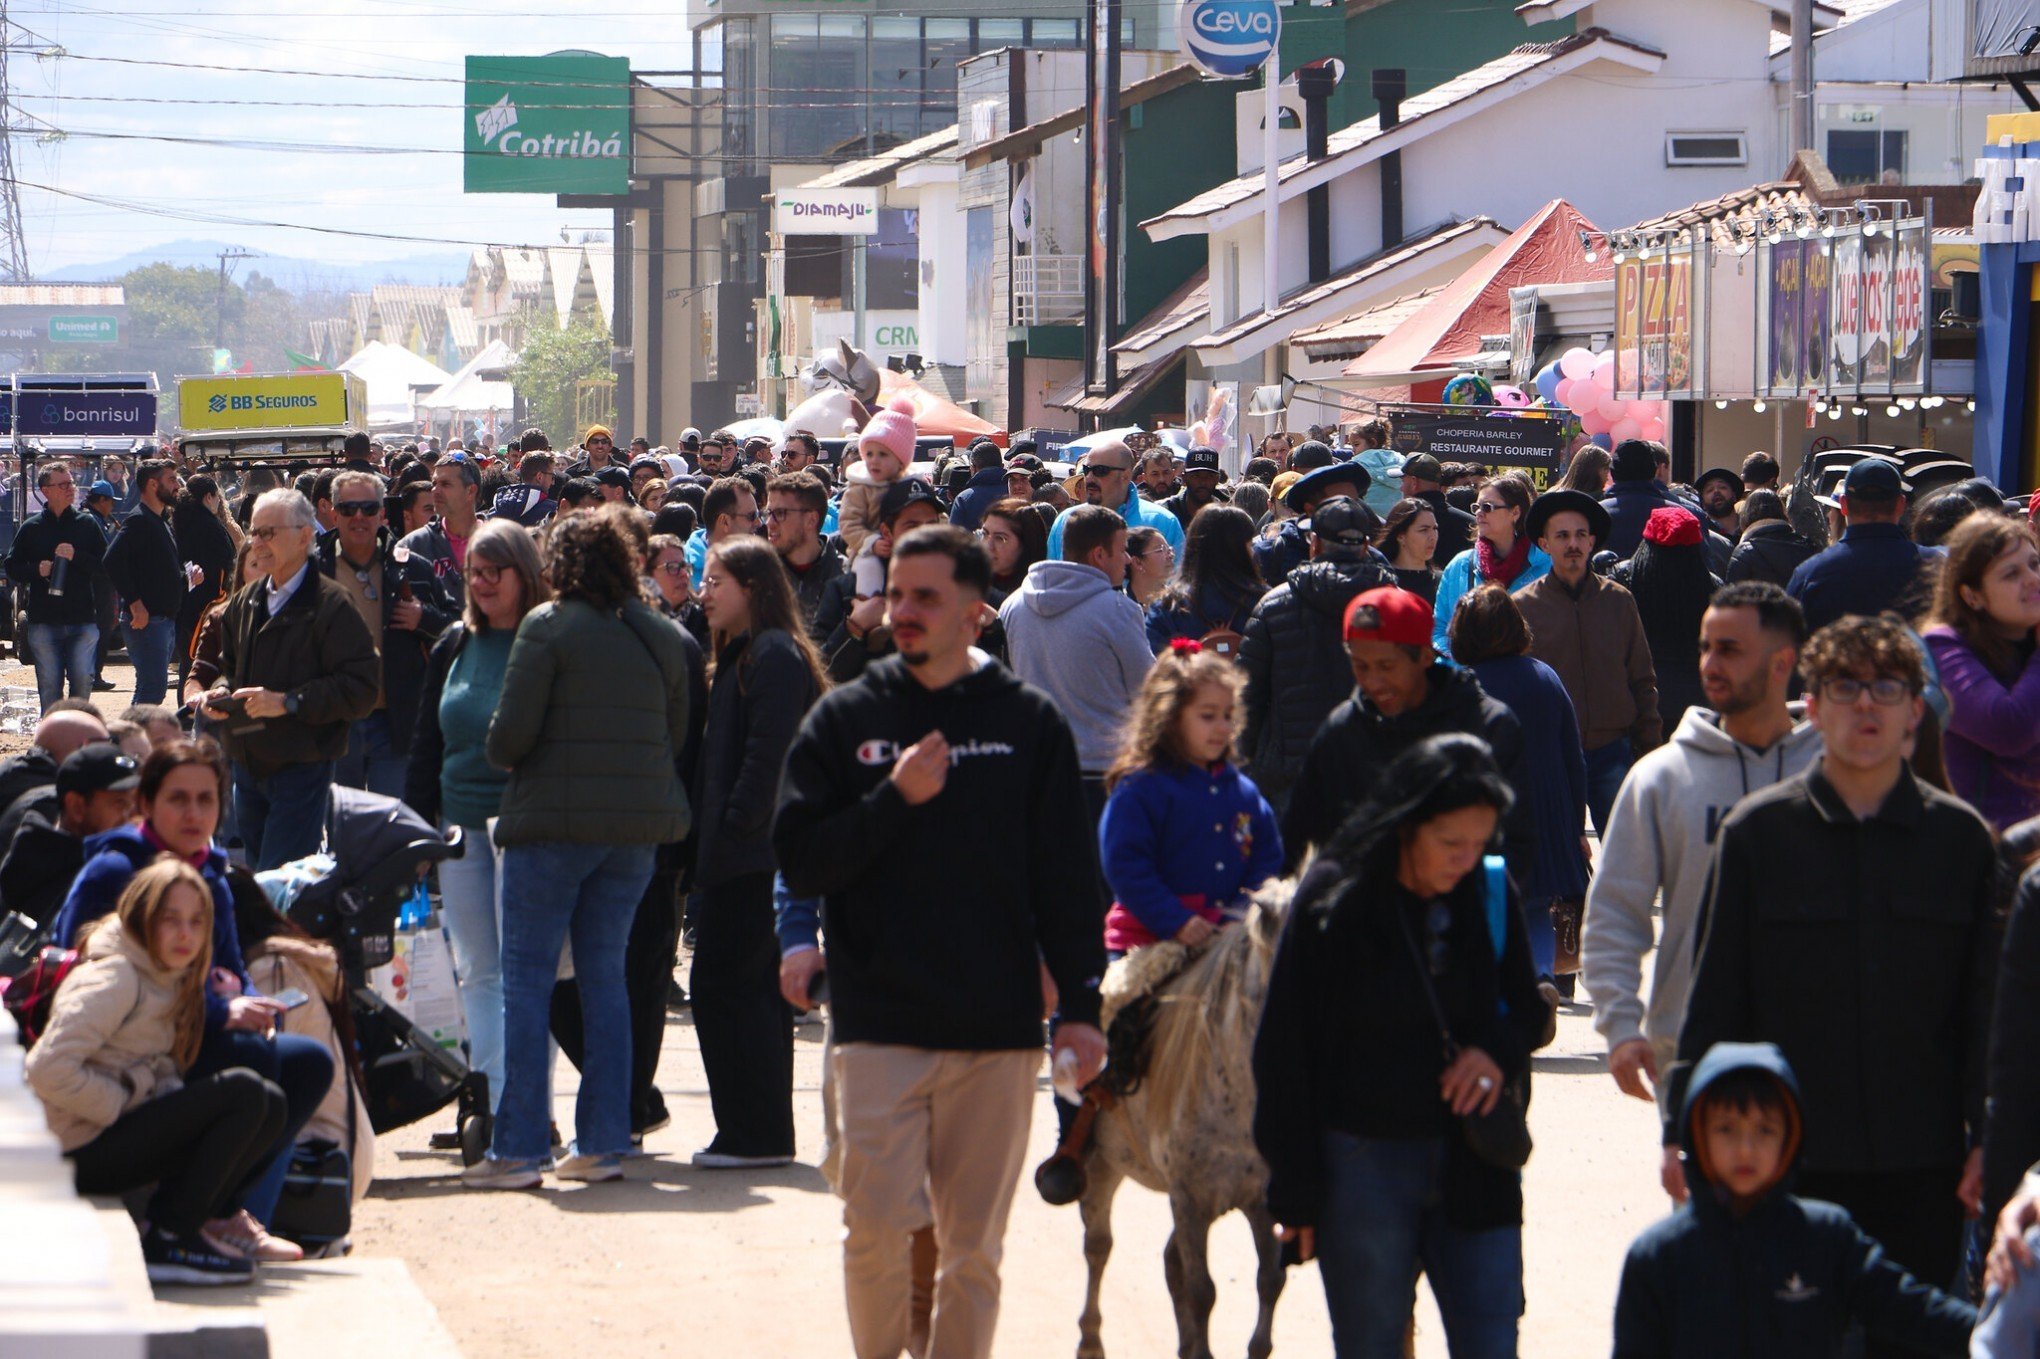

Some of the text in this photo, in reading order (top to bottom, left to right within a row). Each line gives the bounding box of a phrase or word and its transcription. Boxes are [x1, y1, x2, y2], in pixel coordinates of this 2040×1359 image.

[499, 130, 621, 158] Cotribá
[55, 321, 97, 332] Unimed
[230, 395, 253, 410] BB
[63, 406, 140, 422] banrisul
[1436, 428, 1523, 440] CHOPERIA BARLEY
[1430, 442, 1554, 457] RESTAURANTE GOURMET
[856, 738, 1014, 767] Cpion
